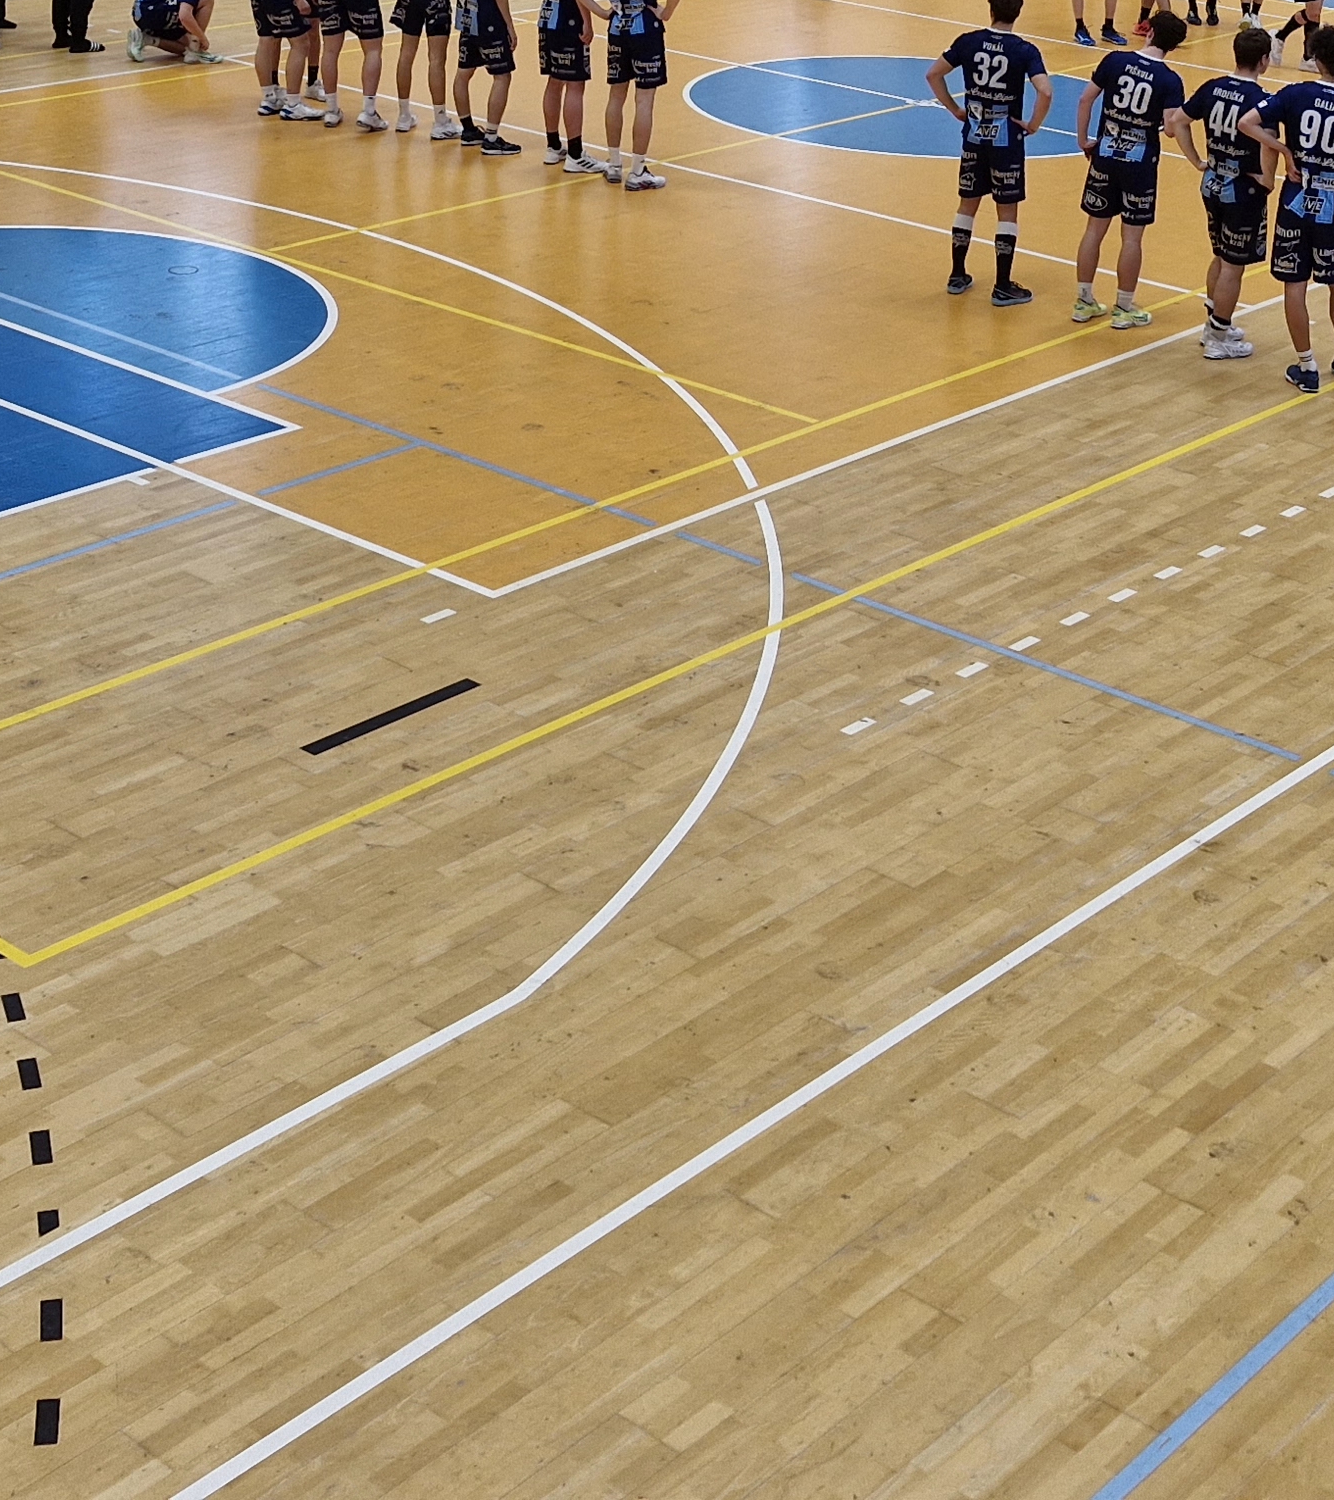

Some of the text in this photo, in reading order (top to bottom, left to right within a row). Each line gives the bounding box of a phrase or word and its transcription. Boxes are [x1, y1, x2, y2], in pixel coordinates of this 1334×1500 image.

[972, 51, 1009, 89] 32
[1124, 64, 1154, 82] PIŠKULA
[1112, 75, 1153, 115] 30
[976, 126, 999, 139] AVE
[1208, 100, 1240, 142] 44
